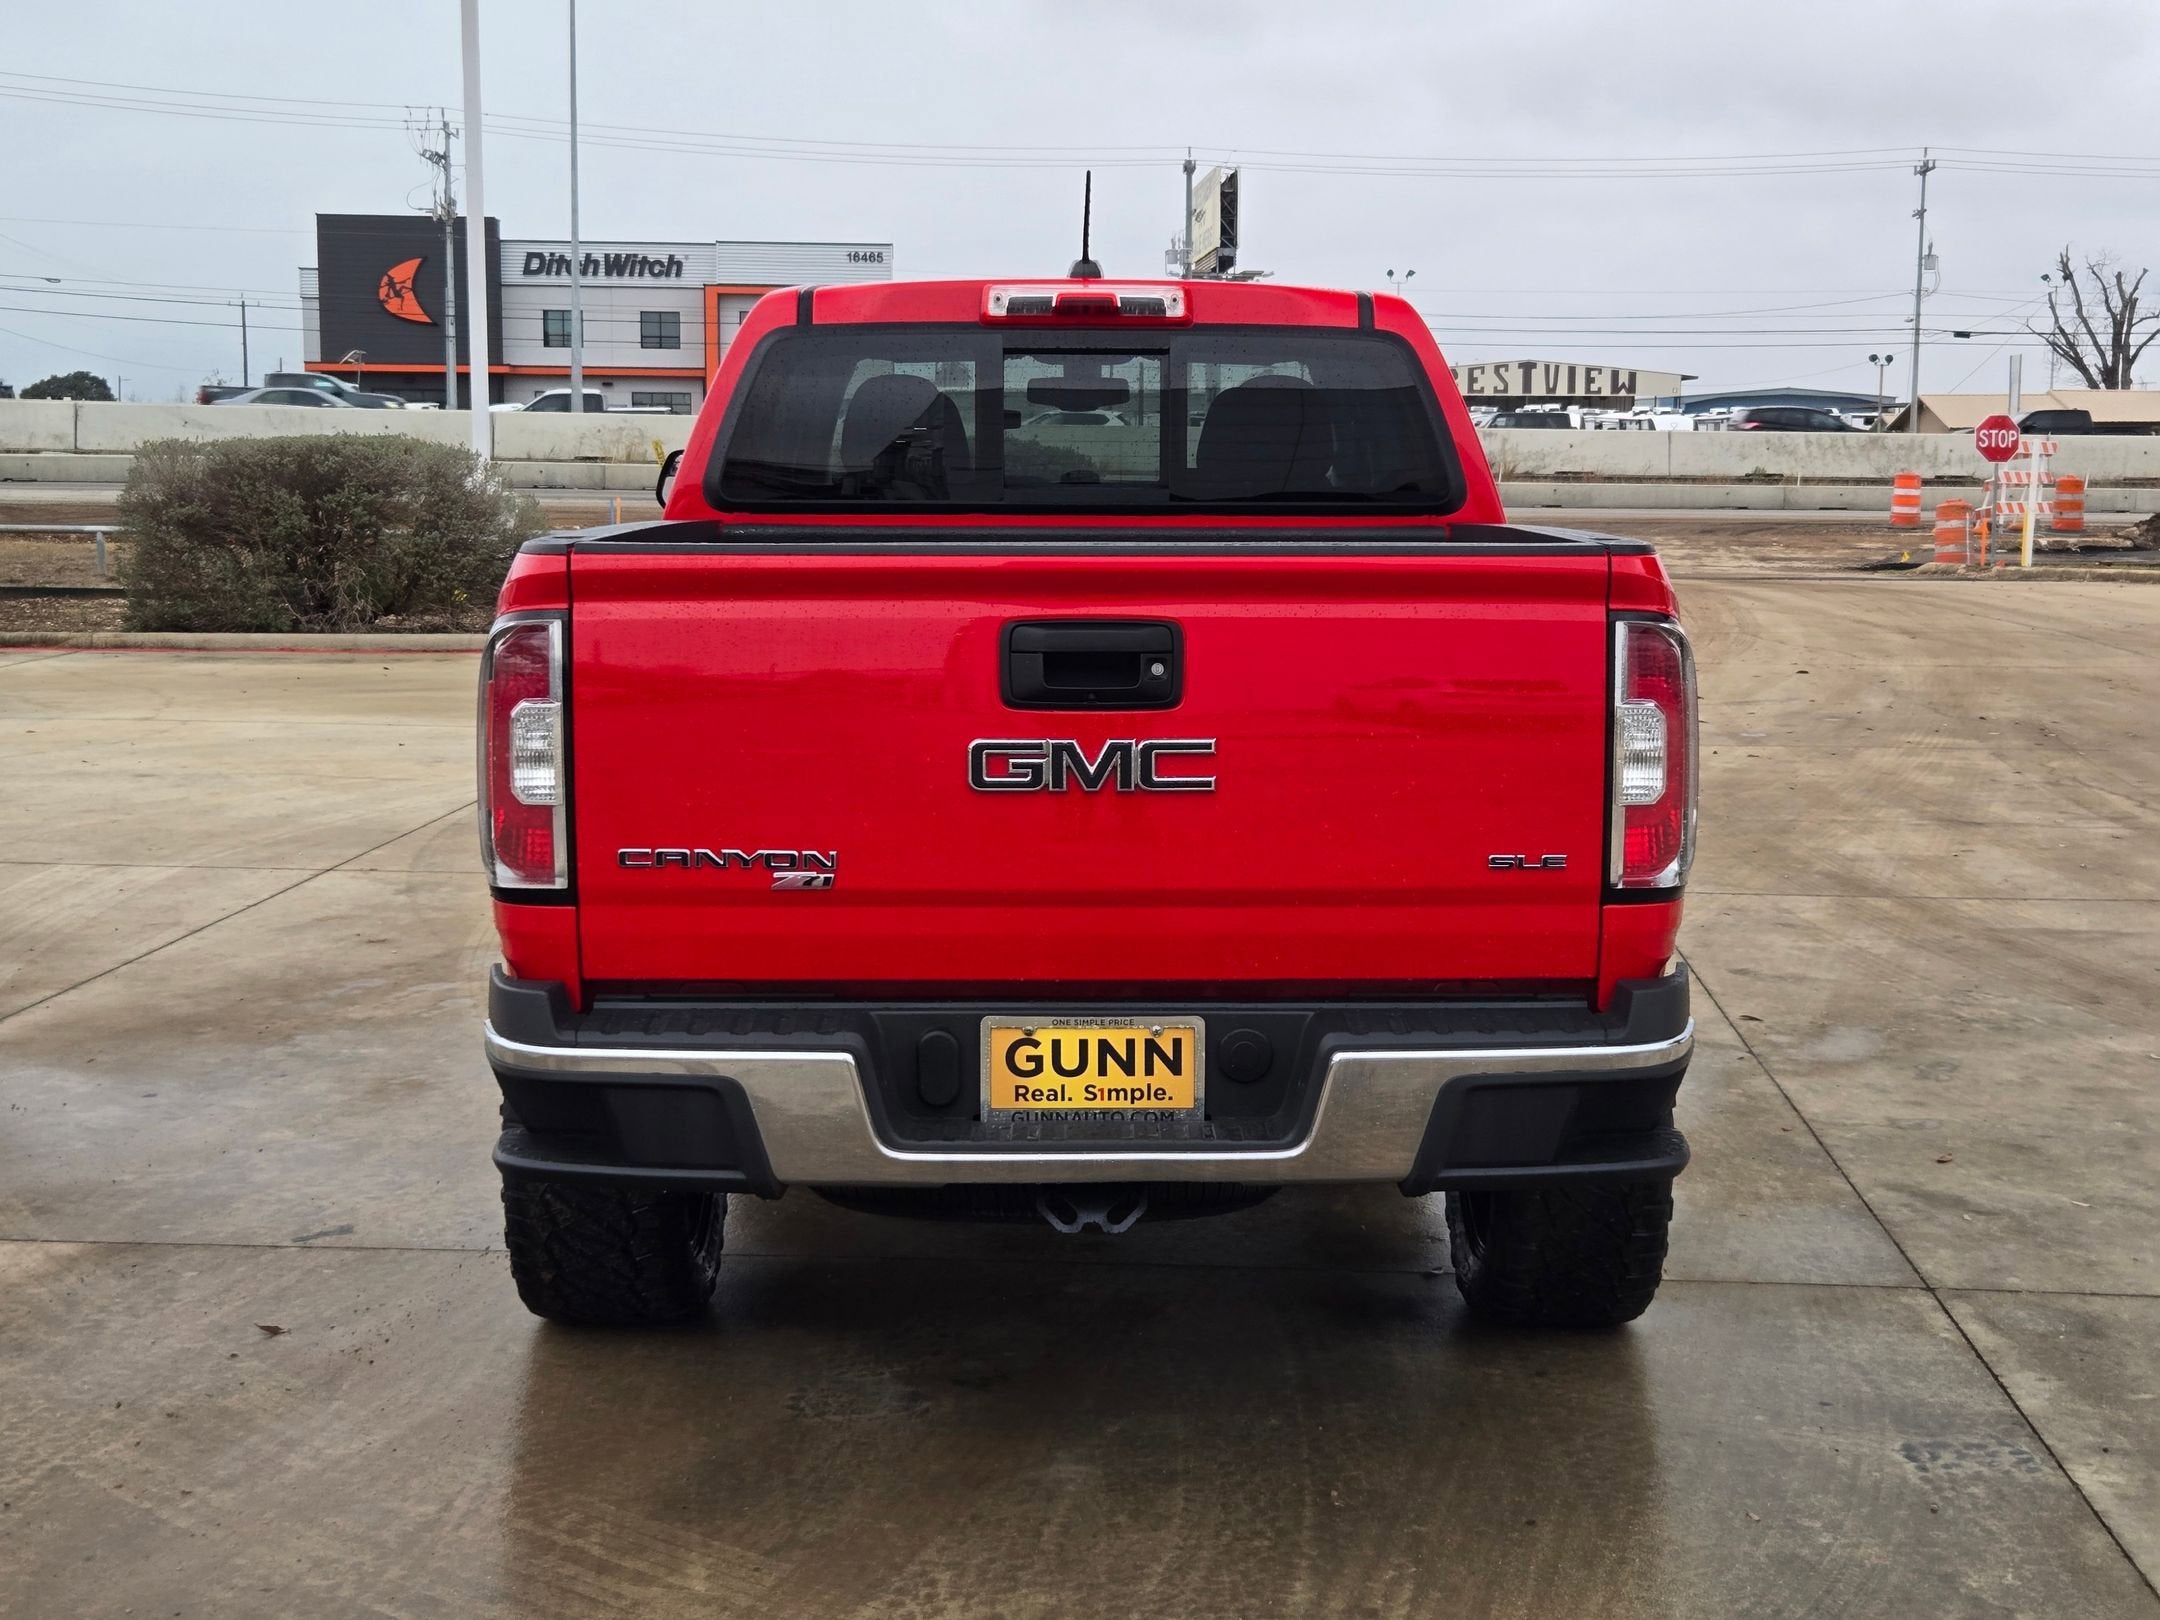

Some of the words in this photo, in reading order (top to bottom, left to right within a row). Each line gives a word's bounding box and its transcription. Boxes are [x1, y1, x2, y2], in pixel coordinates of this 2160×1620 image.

[604, 253, 684, 278] Witch
[846, 251, 884, 263] 16465
[1450, 362, 1637, 395] ESTVIEW
[1978, 429, 2018, 448] STOP
[967, 738, 1217, 792] GMC
[617, 848, 838, 869] CANYON
[1487, 854, 1568, 869] SLE
[770, 871, 835, 890] Z71
[1051, 1018, 1072, 1026] ONE
[1074, 1018, 1106, 1026] SIMPLE
[1108, 1018, 1135, 1026] PRICE
[1005, 1037, 1183, 1078] GUNN
[1014, 1083, 1073, 1102] Real.
[1011, 1110, 1176, 1123] GUNNAUTOCOM
